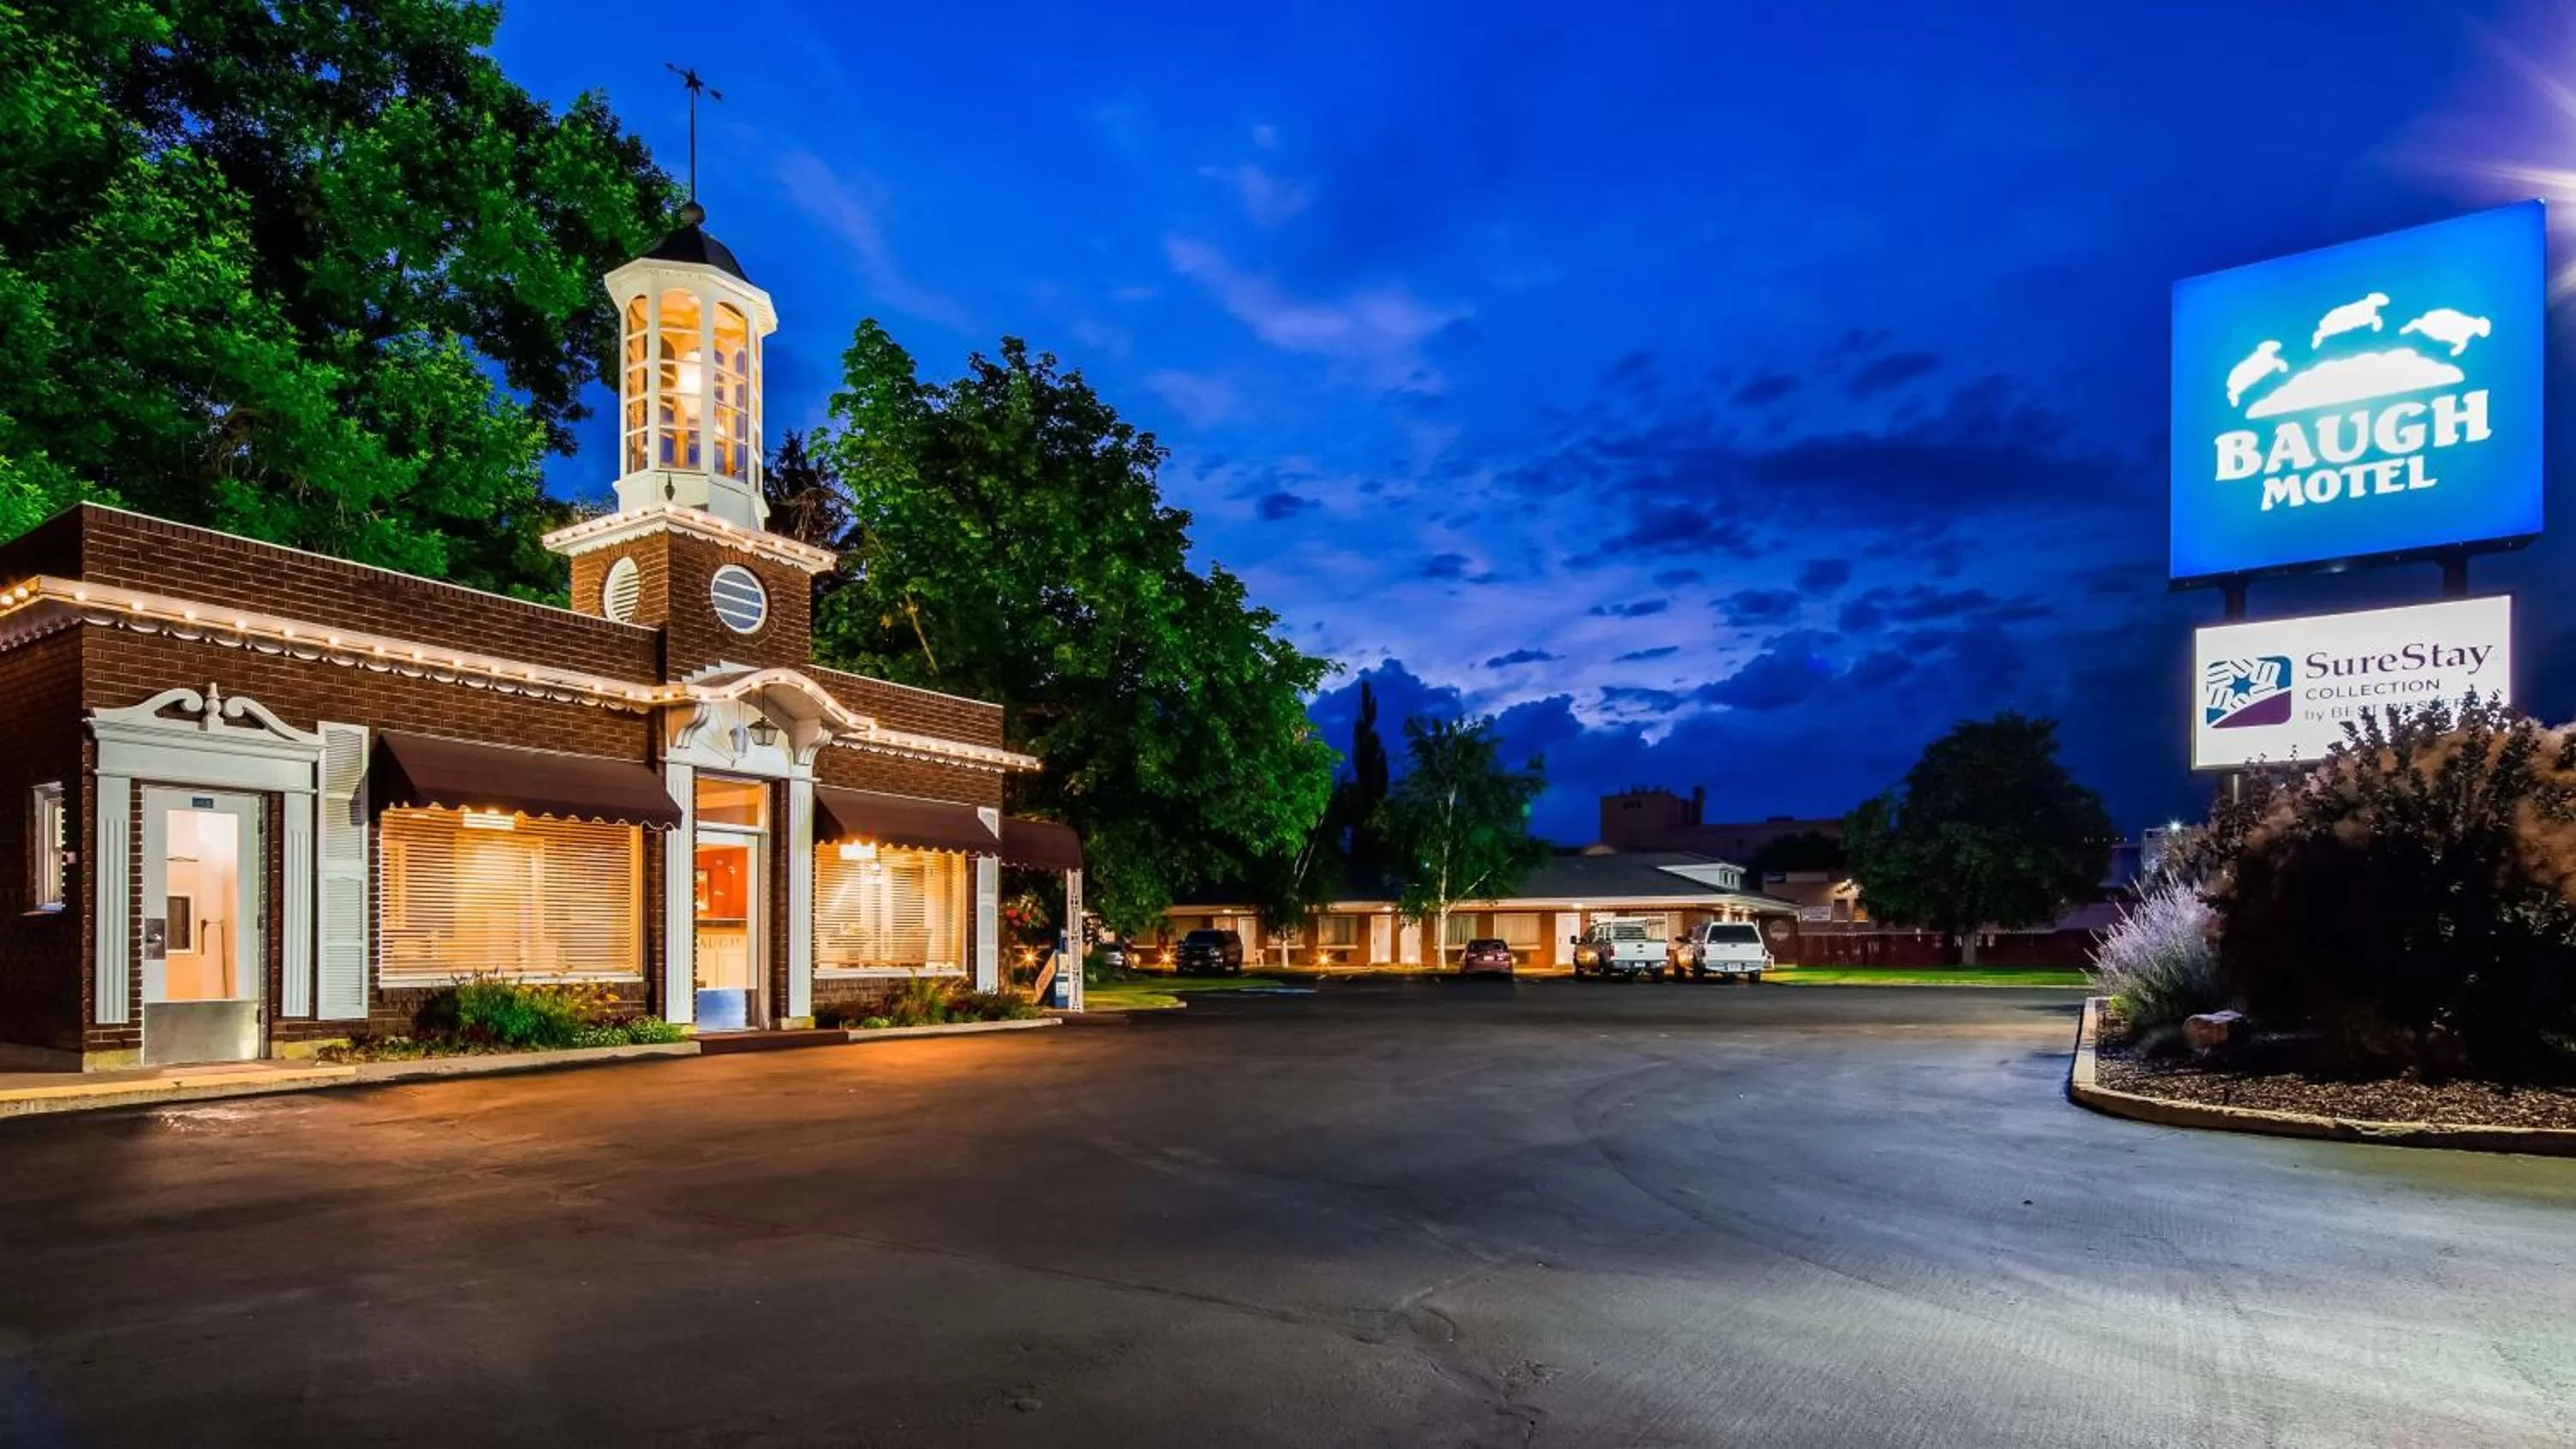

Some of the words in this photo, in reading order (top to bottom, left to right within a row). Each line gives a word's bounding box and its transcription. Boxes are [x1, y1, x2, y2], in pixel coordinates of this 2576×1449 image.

[2215, 389, 2492, 481] BAUGH
[2261, 456, 2437, 511] MOTEL
[2306, 643, 2493, 679] SureStay
[2306, 679, 2440, 700] COLLECTION
